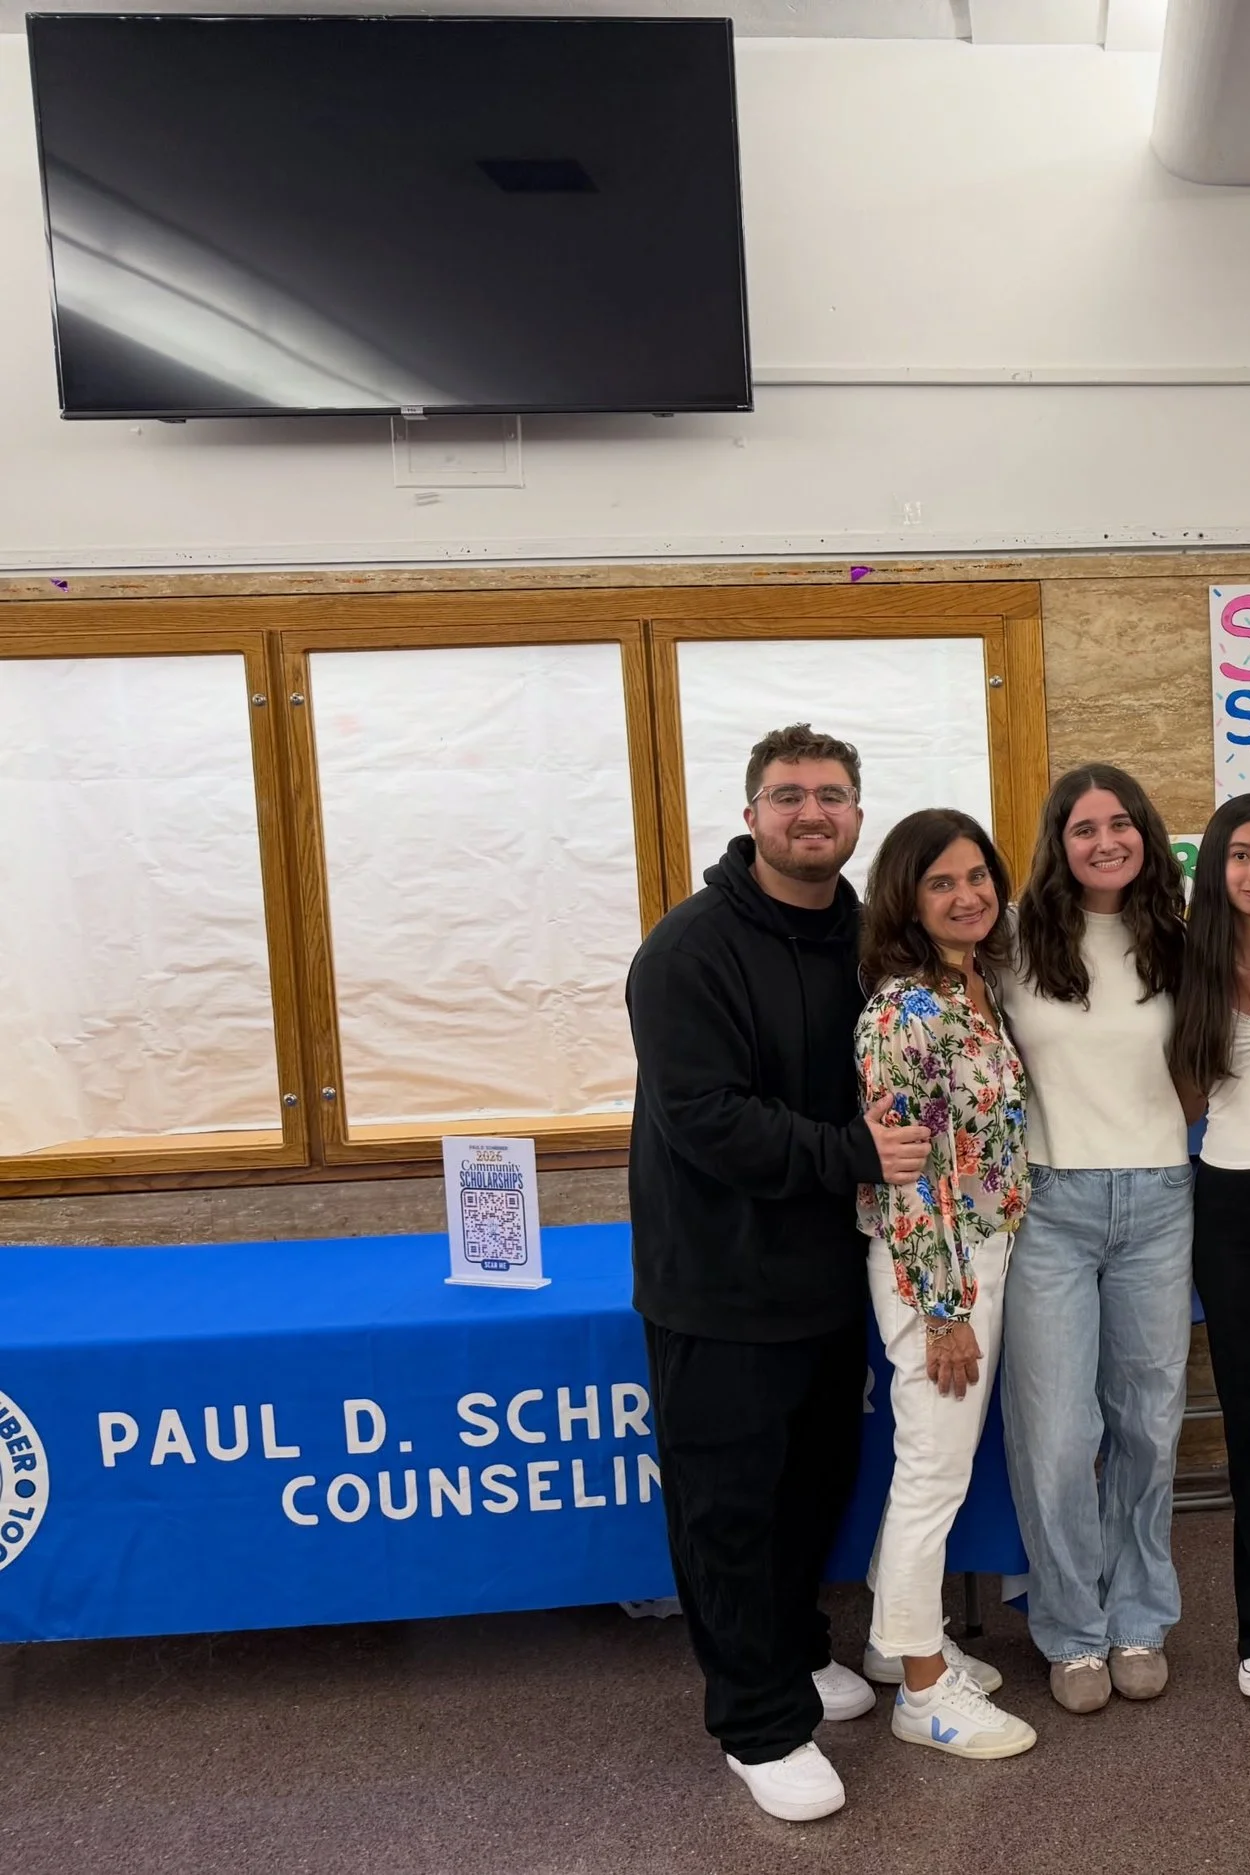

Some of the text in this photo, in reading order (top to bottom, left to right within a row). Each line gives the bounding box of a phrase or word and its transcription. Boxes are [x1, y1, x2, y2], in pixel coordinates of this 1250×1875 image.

[476, 1150, 503, 1161] 2026
[461, 1159, 521, 1172] Community
[460, 1171, 524, 1190] SCHOLARSHIPS
[98, 1403, 300, 1467] PAUL
[345, 1398, 413, 1455] D.
[281, 1454, 662, 1526] COUNSELIN
